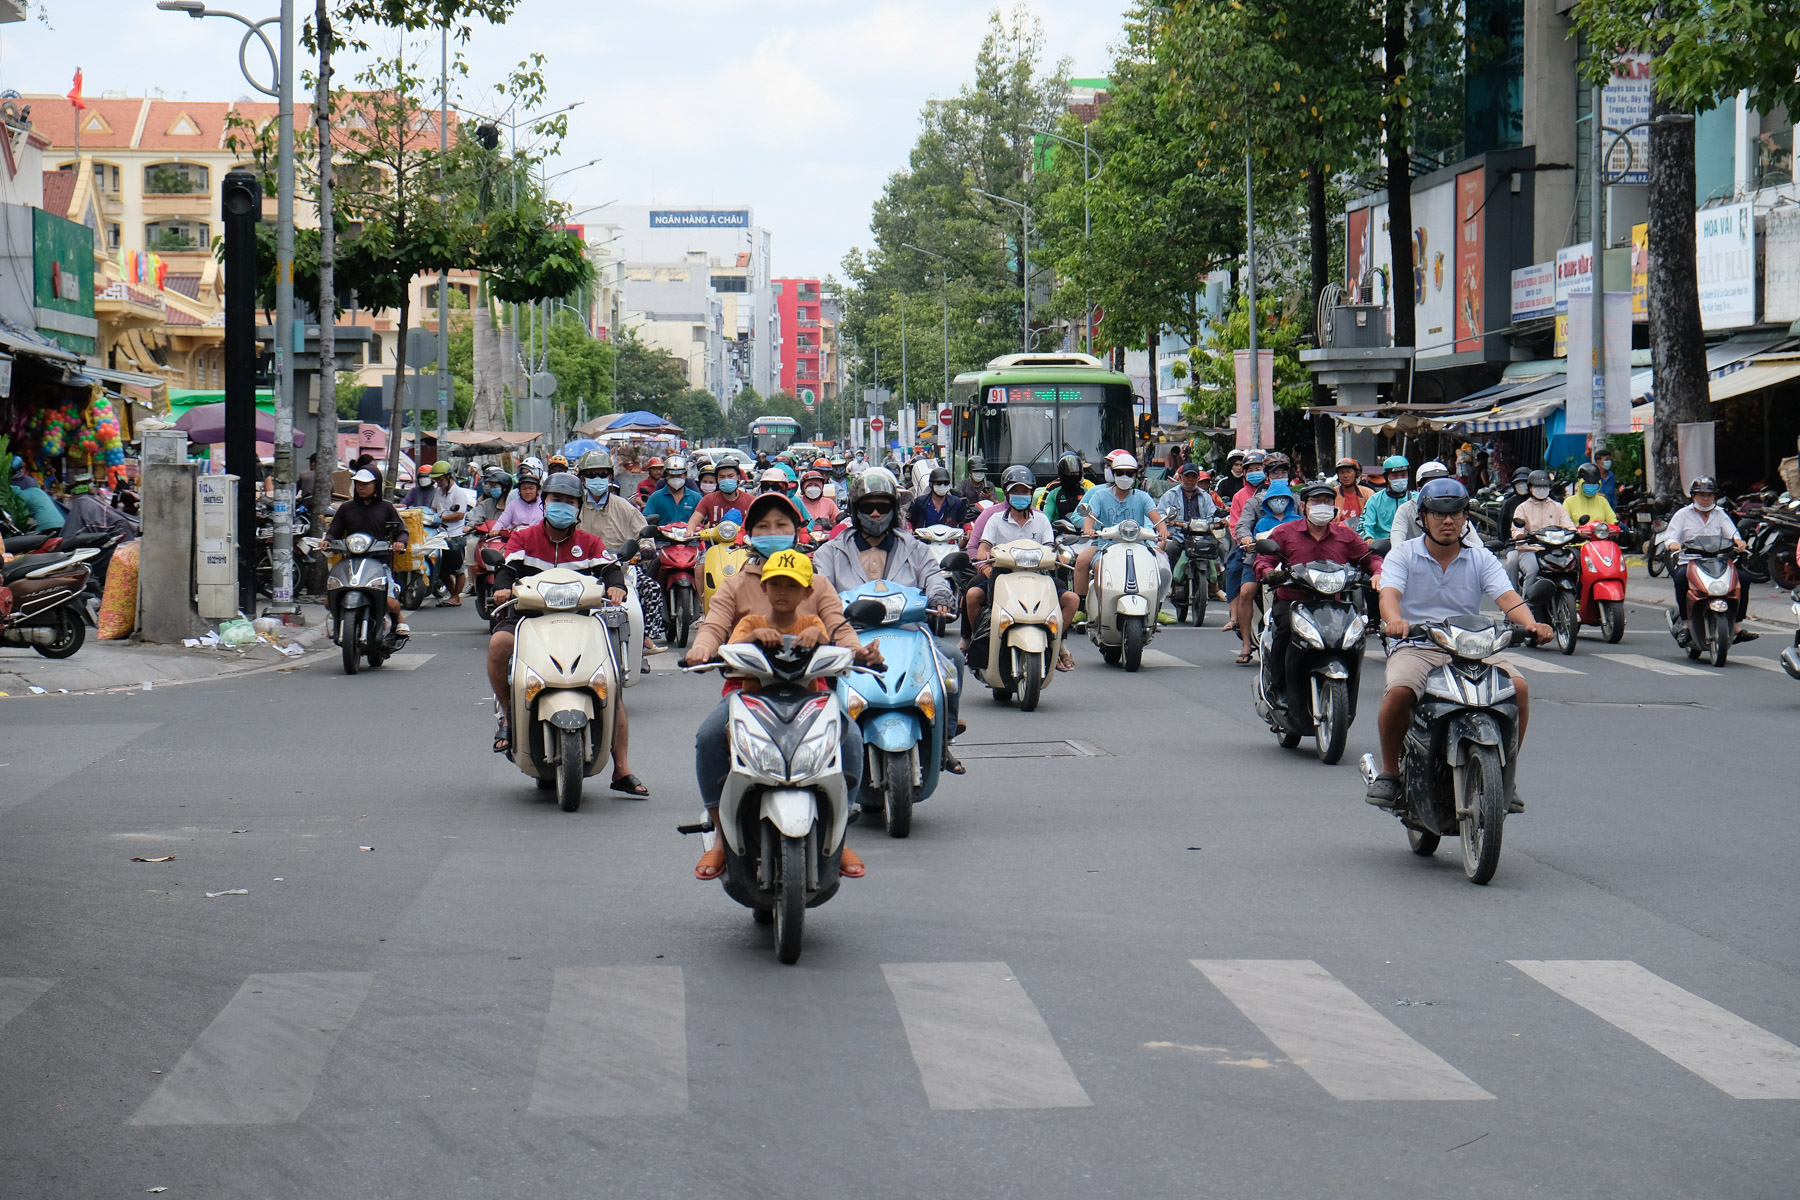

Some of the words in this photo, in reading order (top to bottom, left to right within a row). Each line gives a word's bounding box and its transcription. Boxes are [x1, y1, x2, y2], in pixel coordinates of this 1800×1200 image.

[655, 215, 680, 224] NGÂN
[682, 214, 708, 224] HÀNG
[710, 214, 716, 224] Á
[718, 215, 743, 224] CHÂU
[1704, 220, 1718, 238] HOA
[1720, 210, 1732, 234] VẢI
[992, 389, 1003, 402] 91
